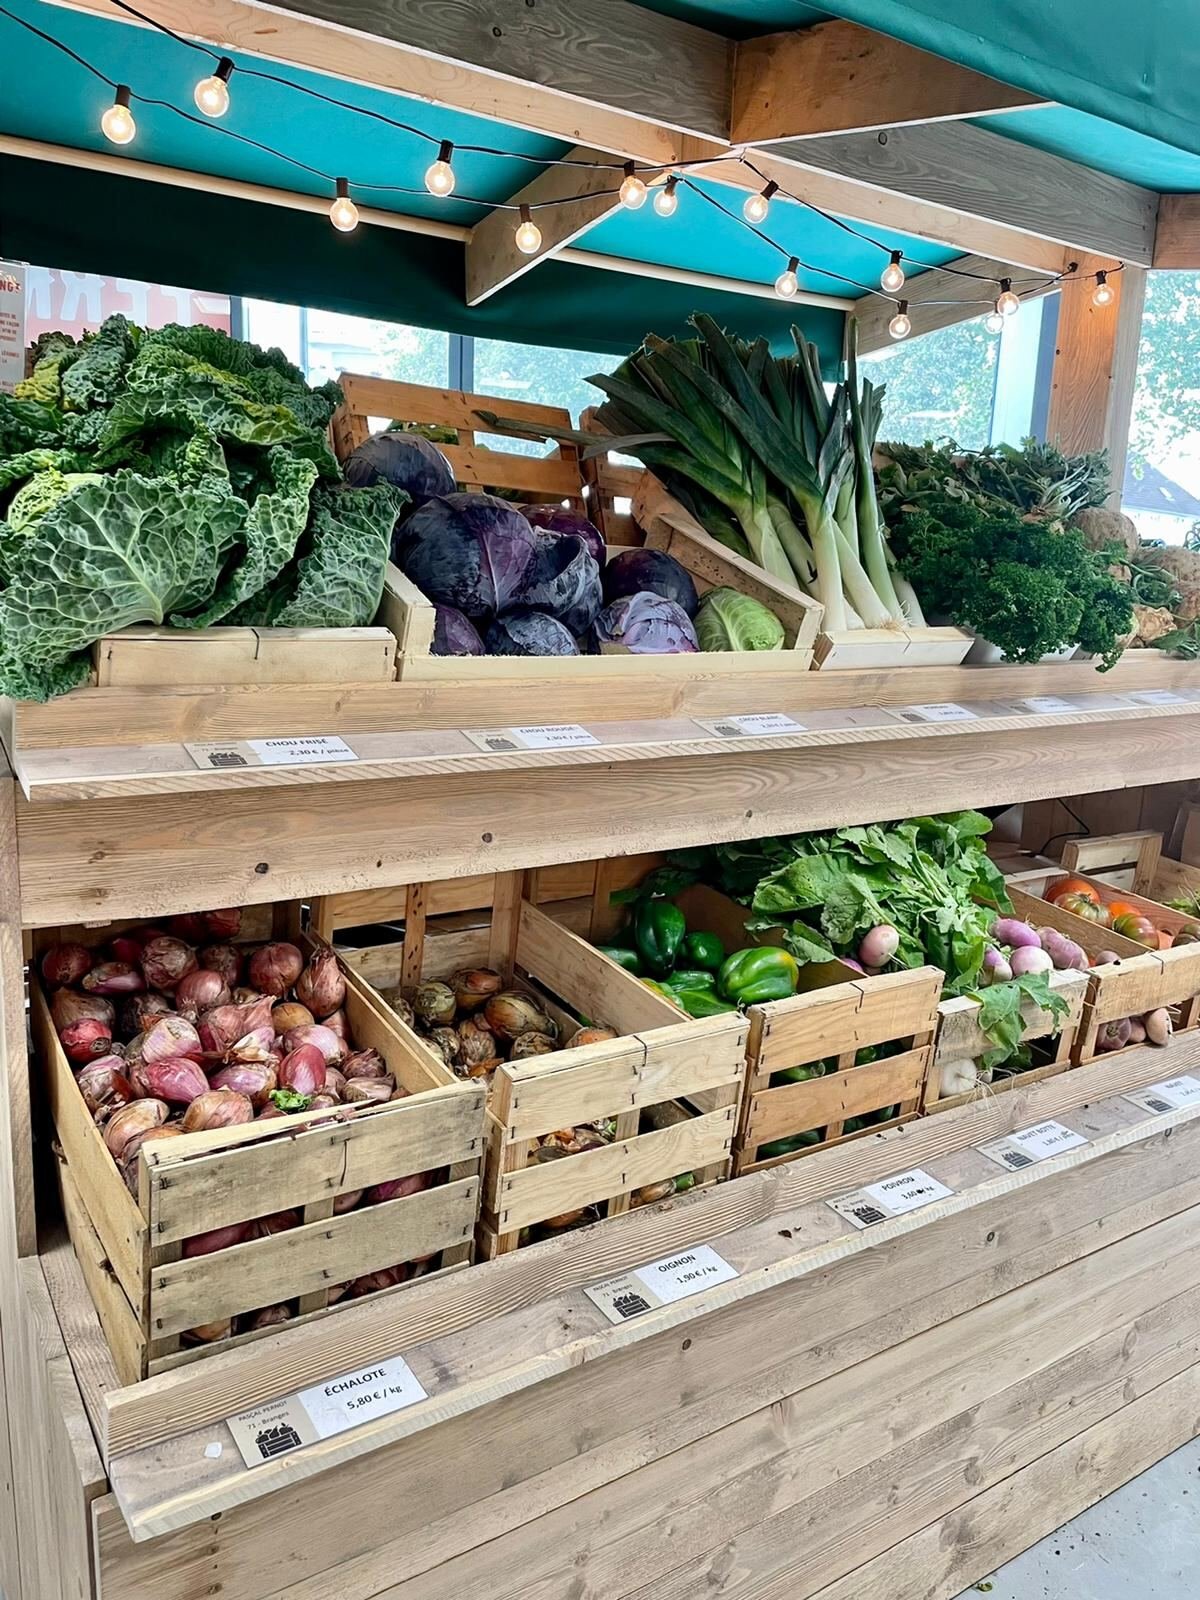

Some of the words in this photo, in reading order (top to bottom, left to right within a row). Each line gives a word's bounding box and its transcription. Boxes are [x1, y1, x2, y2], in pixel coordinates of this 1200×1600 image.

[265, 740, 298, 748] CHOU
[289, 748, 311, 757] 2,30
[658, 1254, 696, 1272] OIGNON
[676, 1271, 696, 1284] 1,90
[706, 1265, 719, 1273] kg
[324, 1367, 387, 1397] ÉCHALOTE
[346, 1394, 373, 1411] 5,80
[373, 1391, 382, 1400] €
[388, 1385, 403, 1394] kg
[261, 1411, 290, 1425] Branges
